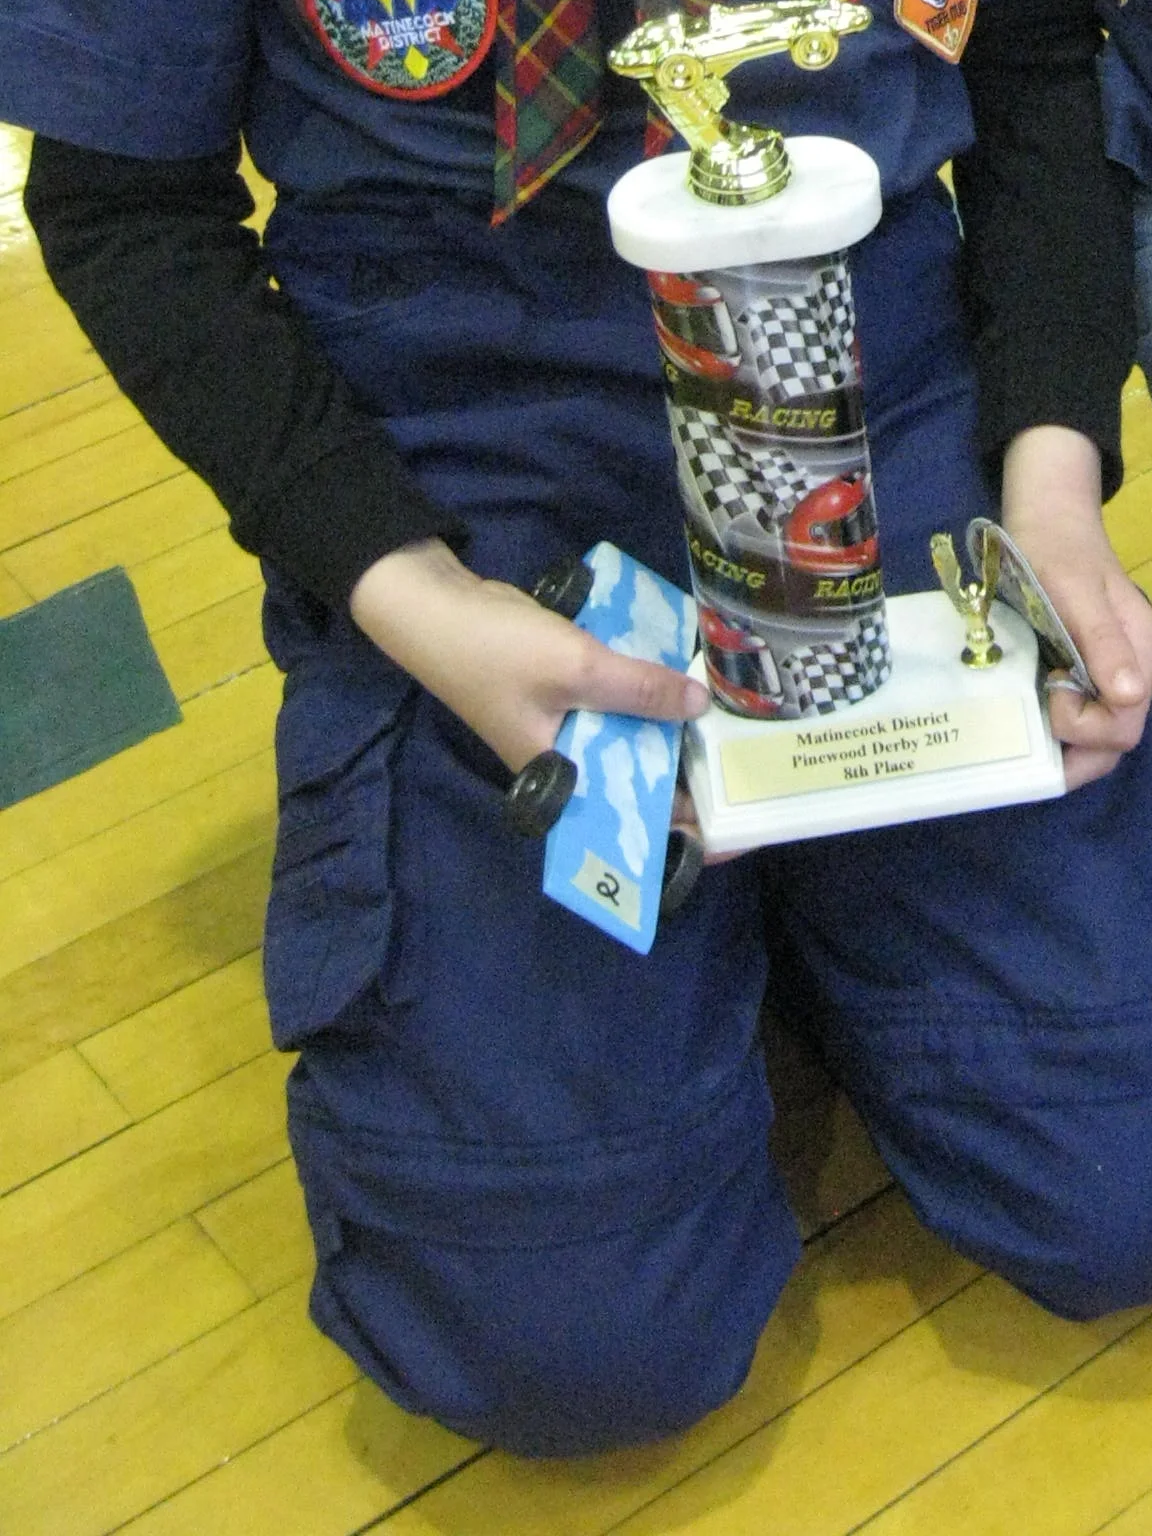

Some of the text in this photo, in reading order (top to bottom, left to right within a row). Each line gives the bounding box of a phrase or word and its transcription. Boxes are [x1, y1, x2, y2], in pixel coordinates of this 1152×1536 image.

[361, 11, 455, 39] MATINECOCK
[377, 27, 442, 51] DISTRICT
[729, 398, 837, 430] RACING
[797, 710, 949, 748] Matinecock District
[792, 728, 961, 769] Pinewood Derby 2017
[843, 757, 915, 781] 8th Place
[596, 872, 621, 907] 2
